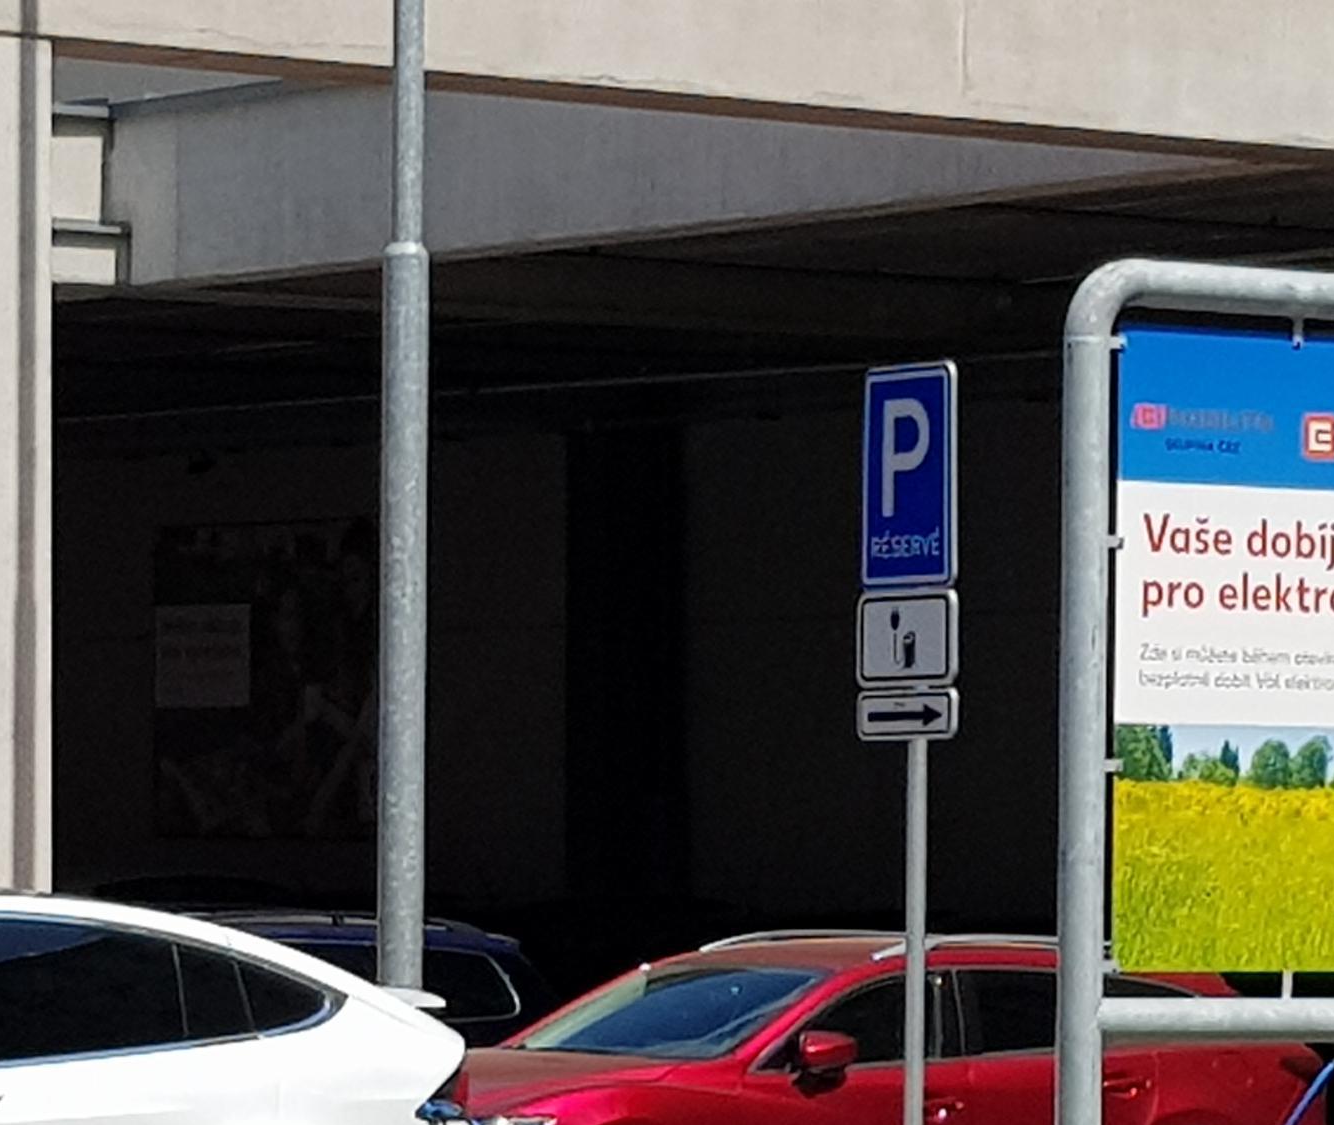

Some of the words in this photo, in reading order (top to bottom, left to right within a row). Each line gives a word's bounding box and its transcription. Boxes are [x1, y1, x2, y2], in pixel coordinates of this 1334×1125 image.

[882, 397, 931, 518] P
[1142, 512, 1233, 556] Vaše
[1141, 578, 1205, 618] pro
